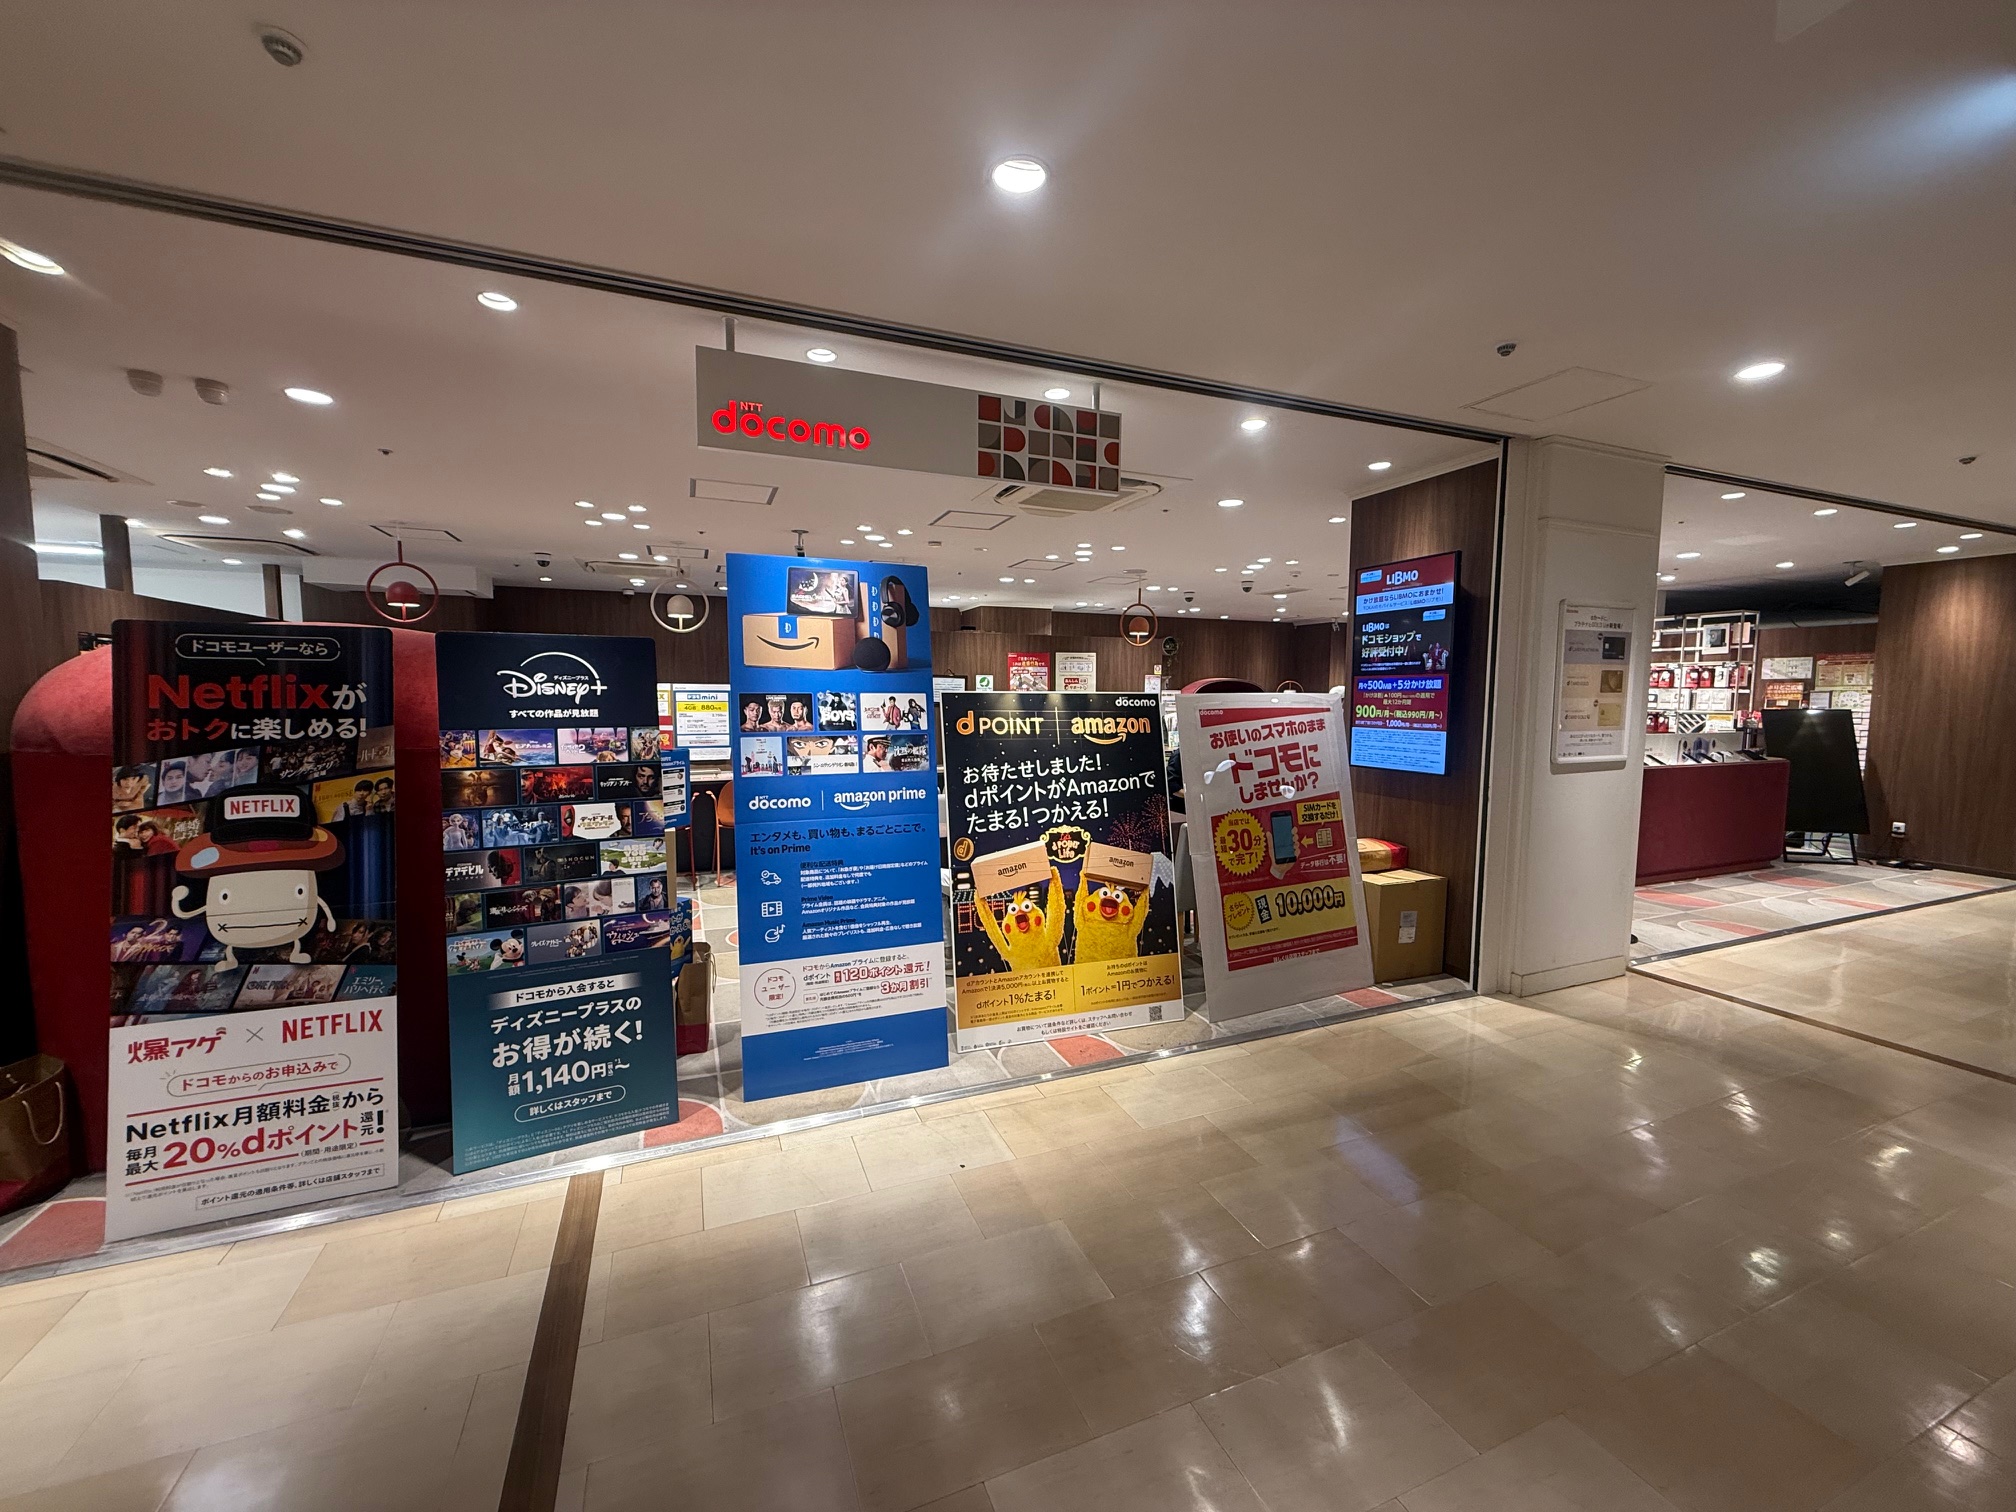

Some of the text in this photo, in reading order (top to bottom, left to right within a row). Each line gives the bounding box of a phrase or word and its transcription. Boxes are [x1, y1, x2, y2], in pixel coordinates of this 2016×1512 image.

[740, 401, 763, 413] NTT
[711, 400, 872, 452] docomo
[1386, 570, 1418, 585] LIBMO
[1363, 587, 1444, 605] かけ放題ならLIBMOにおまかせ!
[1362, 631, 1422, 645] ドコモショップで
[192, 640, 329, 656] ドコモユーザーなら
[1362, 645, 1408, 658] 好評受付中!
[148, 674, 367, 711] Netflixが
[1115, 696, 1156, 707] docomo
[509, 709, 599, 719] すべての作品が見放題
[822, 710, 855, 722] BOYS
[147, 717, 367, 741] おトクに楽しめる!
[956, 710, 1150, 736] d POINT amazon
[1209, 718, 1326, 749] お使いのスマホのまま
[963, 753, 1102, 784] お待たせしました!
[1229, 742, 1321, 784] ドコモに
[964, 770, 1156, 809] dポイントがAmazonで
[229, 798, 296, 816] NETFLIX
[749, 787, 926, 810] docomo amazon prime
[1303, 803, 1336, 811] SIMカードを
[966, 797, 1109, 834] たまる!つかえる!
[1228, 818, 1250, 826] 当店では
[1301, 812, 1339, 823] 交換するだけ!
[750, 823, 926, 843] エンタメも、買い物も、まるごとここで。
[750, 843, 811, 855] It's on Prime
[1058, 848, 1075, 859] Life
[1109, 856, 1134, 867] amazon
[1228, 852, 1258, 866] で完了!
[1300, 853, 1346, 869] データ移行は不要!
[445, 865, 484, 878] デアデビル
[997, 862, 1027, 876] amazon
[1229, 901, 1245, 911] さらに
[1256, 885, 1345, 920] 現金 10,000円
[1228, 905, 1251, 922] プレゼント
[803, 973, 831, 981] dポイント
[344, 985, 385, 994] パリへ行く
[515, 979, 615, 1003] ドコモから入会すると
[761, 984, 791, 993] ユーザー
[976, 989, 1056, 1009] dポイント1%たまる!
[490, 996, 642, 1034] ディズニープラスの
[128, 1026, 227, 1064] 爆アゲ
[282, 1010, 383, 1043] NETFLIX
[492, 1020, 643, 1068] お得が続く!
[182, 1061, 339, 1091] ドコモからのお申込みで
[508, 1073, 520, 1096] 月額
[522, 1060, 607, 1094] 1,140円
[529, 1090, 613, 1116] 詳しくはスタッフまで
[125, 1160, 159, 1177] 最大
[162, 1119, 358, 1169] 20%dポイント
[126, 1146, 157, 1161] 毎月
